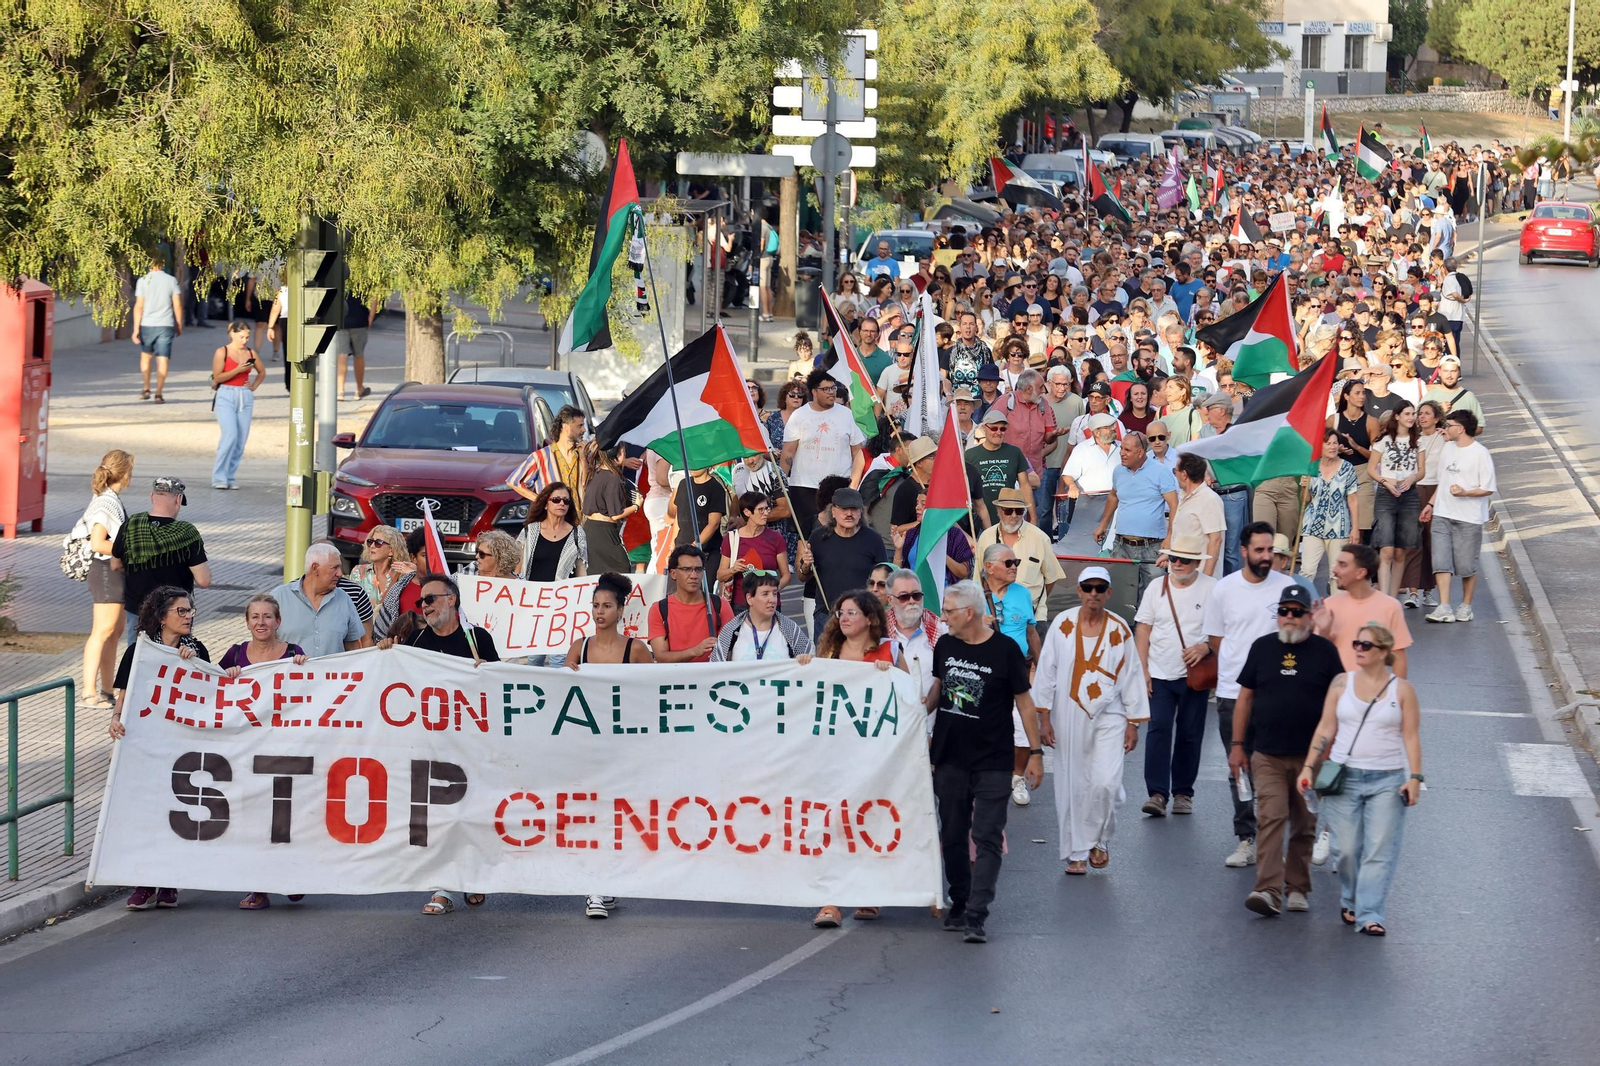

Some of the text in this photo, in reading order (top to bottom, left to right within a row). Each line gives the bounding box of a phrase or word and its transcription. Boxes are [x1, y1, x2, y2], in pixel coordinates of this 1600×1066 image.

[1349, 22, 1374, 33] ARENAL
[435, 521, 457, 533] KZH
[476, 580, 647, 612] PALESTA
[506, 610, 600, 650] LIBR
[979, 665, 993, 674] con
[140, 665, 898, 739] JEREZ CON PALESTINA
[168, 751, 902, 856] STOP GENOCIDIO
